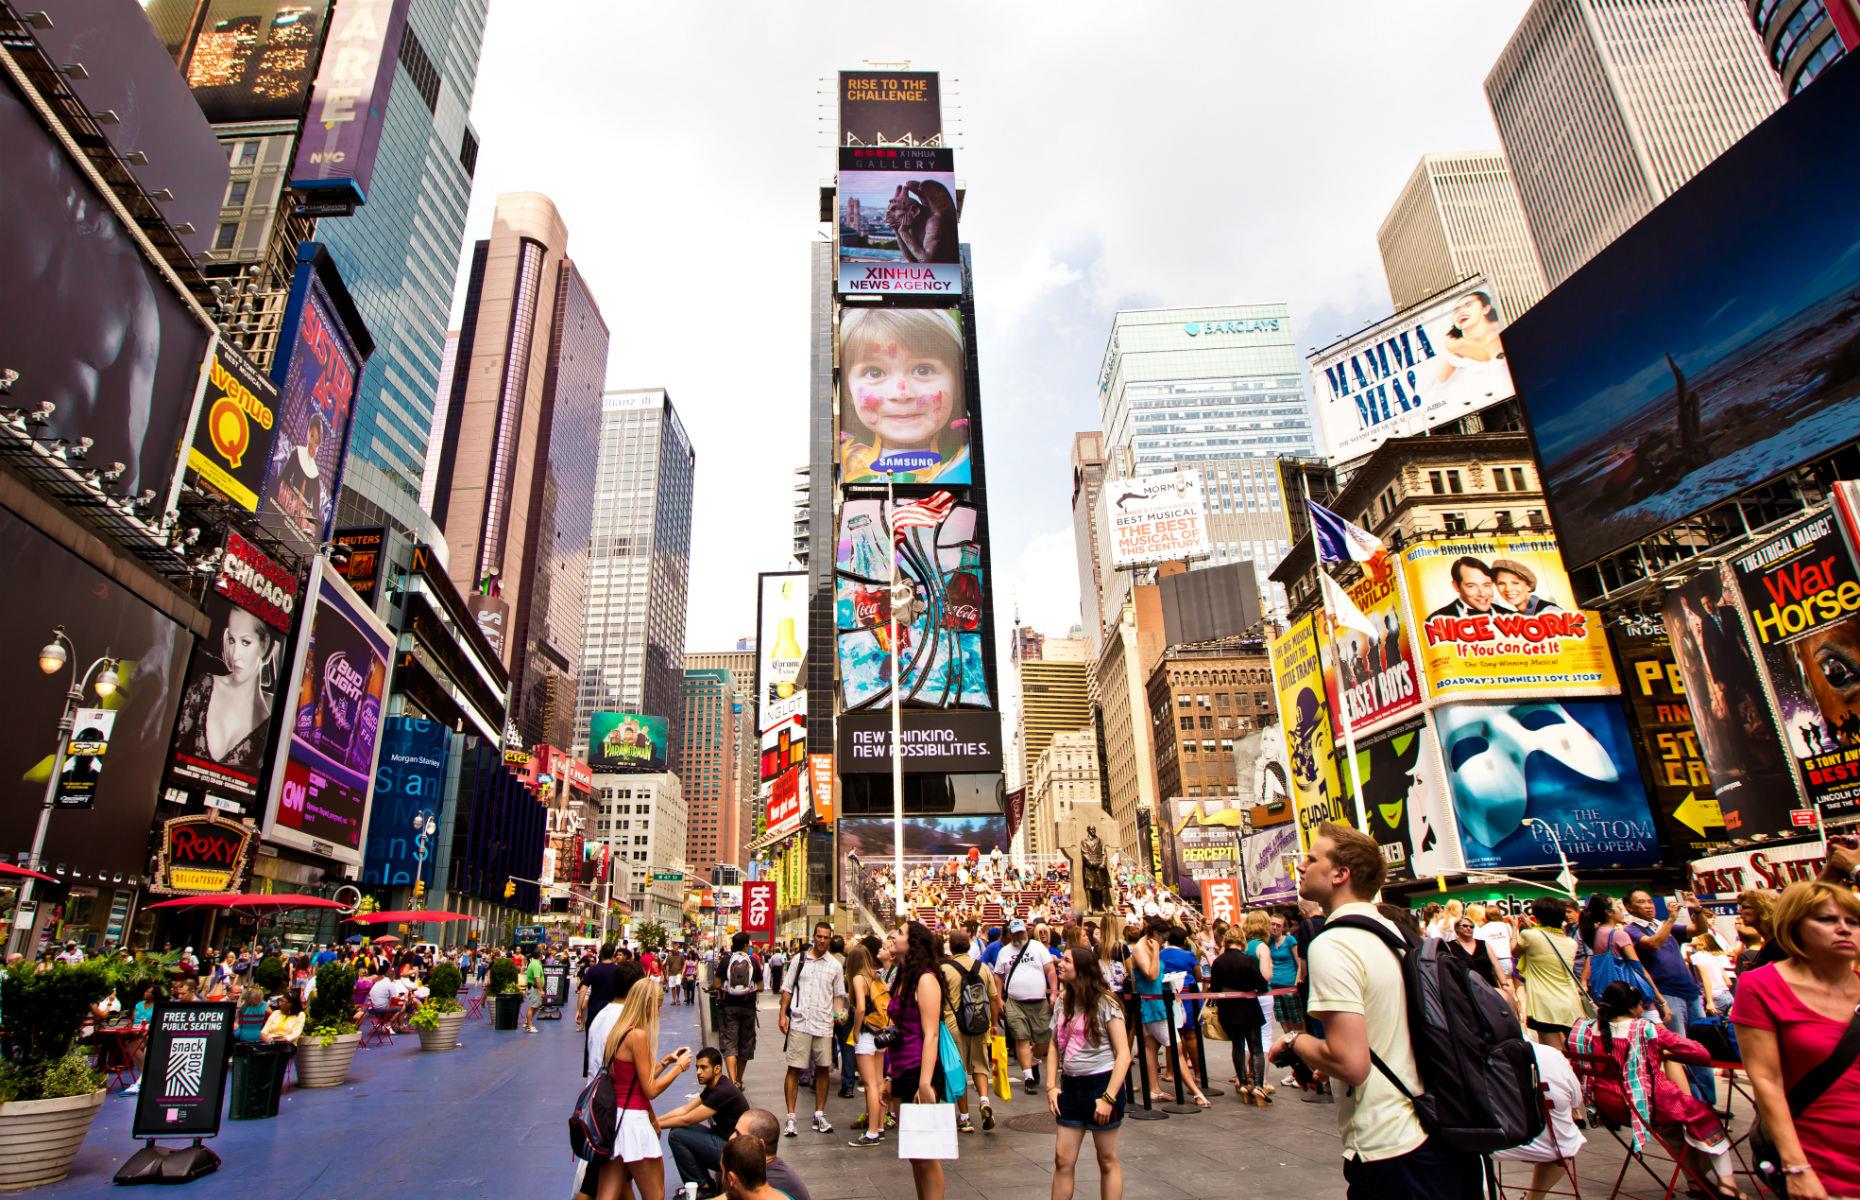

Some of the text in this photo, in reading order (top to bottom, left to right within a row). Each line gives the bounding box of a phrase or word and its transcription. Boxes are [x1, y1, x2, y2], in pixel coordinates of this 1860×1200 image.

[848, 79, 928, 91] RISE TO THE
[847, 90, 928, 102] CHALLENGE.
[310, 152, 346, 164] NYC
[899, 150, 936, 158] XINHUA
[855, 160, 936, 169] GALLERY
[865, 266, 936, 280] XINHUA
[849, 280, 952, 291] NEWS AGENCY
[1203, 319, 1280, 335] BARCLAYS
[1324, 324, 1437, 403] MAMMA
[1354, 370, 1422, 431] MIA!
[209, 397, 250, 470] Q
[879, 457, 934, 467] SAMSUNG
[1116, 515, 1143, 526] BEST
[1147, 508, 1198, 520] MUSICAL
[1119, 517, 1198, 538] THE BEST
[339, 535, 381, 545] REUTERS
[1119, 528, 1200, 548] MUSICAL OF
[1120, 540, 1200, 556] THIS CENTURY
[1407, 546, 1439, 561] Matthew
[1440, 543, 1496, 556] BRODERICK
[224, 553, 293, 614] CHICAGO
[1762, 555, 1837, 608] War
[1753, 580, 1860, 644] Horse
[1424, 615, 1495, 647] NICE
[1493, 611, 1587, 643] WORK
[1457, 642, 1560, 657] If You Can Get It
[1530, 658, 1559, 667] Musical
[337, 658, 363, 689] BUD
[1280, 654, 1317, 692] LITTLE TRAMP
[1436, 673, 1603, 689] BROADWAY'S FUNNIEST LOVE STORY
[329, 667, 363, 702] LIGHT
[1338, 659, 1415, 724] ERSEY BOYS
[764, 696, 803, 725] INGLOT
[853, 731, 885, 744] NEW
[73, 742, 102, 754] SPY
[853, 745, 885, 758] NEW
[391, 753, 441, 768] Morgan Stanley
[1804, 759, 1816, 771] 5
[1816, 753, 1842, 768] TONY
[1809, 761, 1859, 785] BEST
[1815, 790, 1852, 804] LINCOLN
[1826, 799, 1854, 810] TAKE THE
[1300, 795, 1346, 831] CHAPLIN
[1571, 808, 1601, 821] THE
[1531, 820, 1653, 842] PHANTOM
[1565, 842, 1597, 854] THE
[1597, 840, 1648, 853] OPERA
[175, 874, 224, 885] DELICATESSEN
[749, 885, 771, 926] tkts
[163, 1011, 224, 1022] FREE & OPEN
[161, 1022, 222, 1031] PUBLIC SEATING
[171, 1039, 204, 1053] snack
[187, 1052, 203, 1075] BOX
